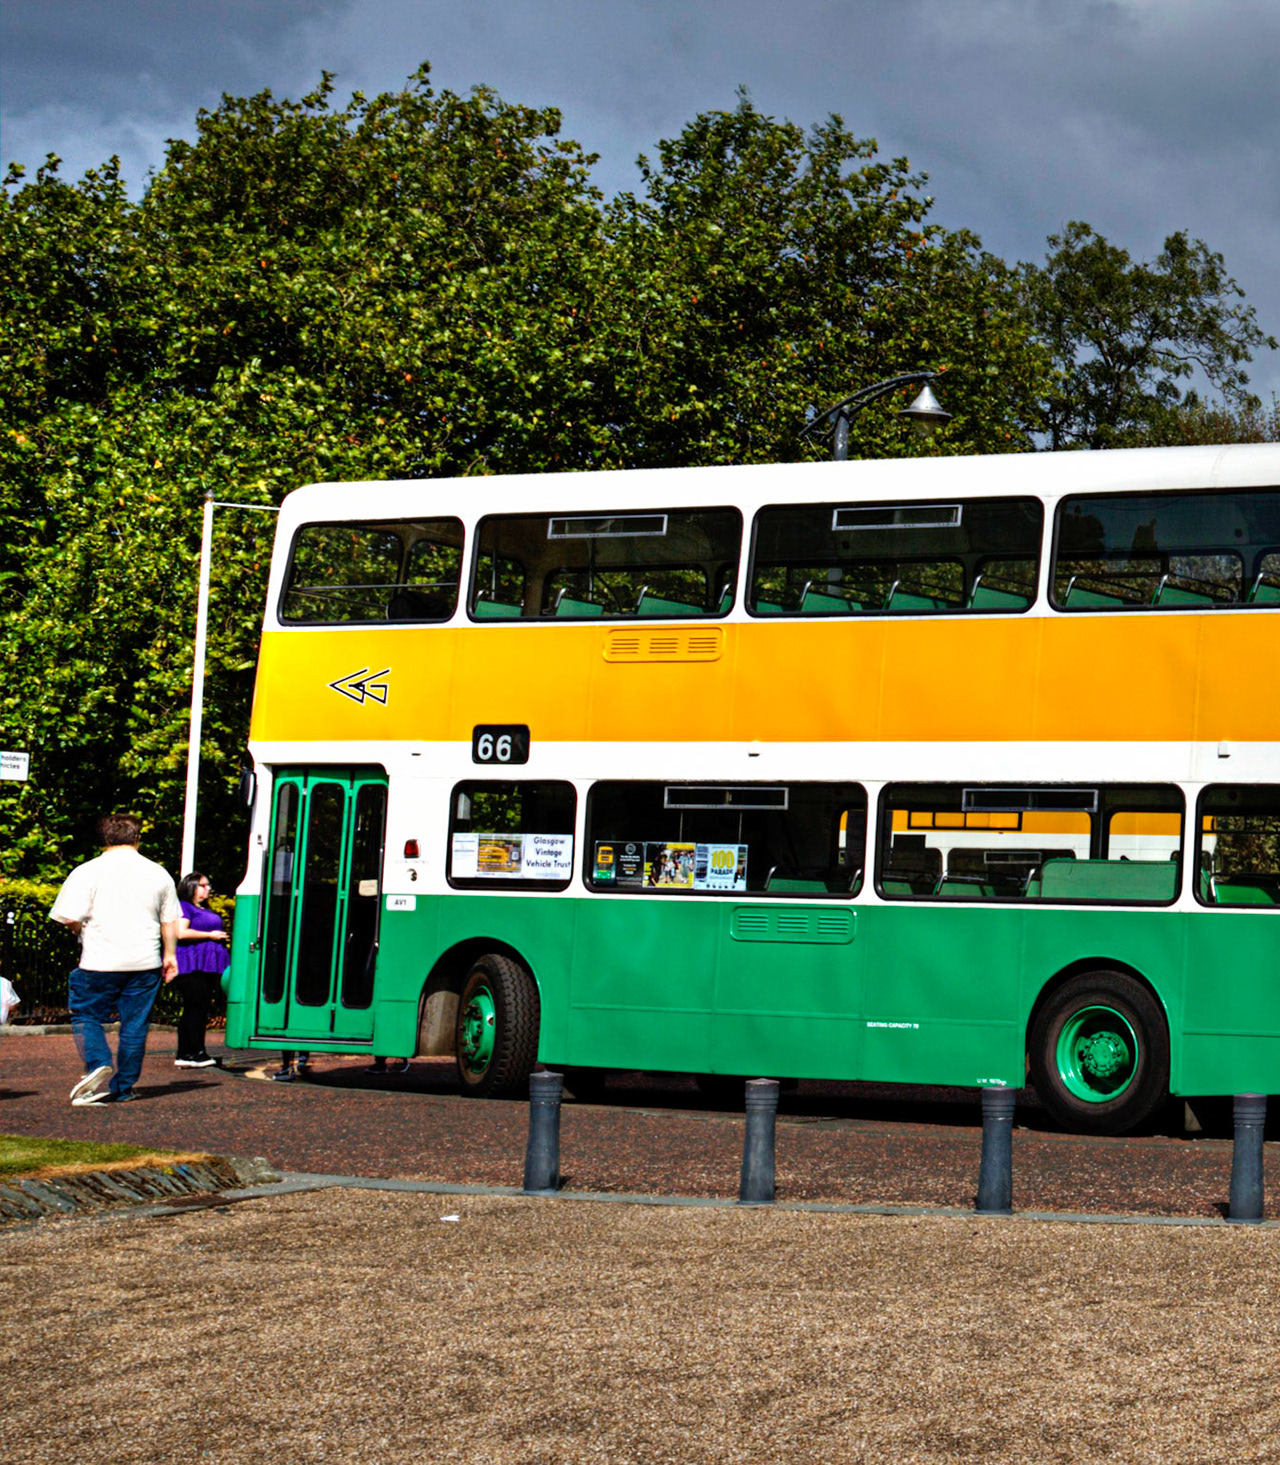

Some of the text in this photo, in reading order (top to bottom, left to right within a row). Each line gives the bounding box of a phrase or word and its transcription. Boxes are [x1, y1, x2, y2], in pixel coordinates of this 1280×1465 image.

[477, 733, 512, 762] 66
[533, 837, 565, 845] Glasgow
[535, 849, 562, 857] Vintage
[711, 849, 735, 869] 100
[526, 860, 571, 868] Vehicle Trust
[710, 868, 733, 876] PARADE
